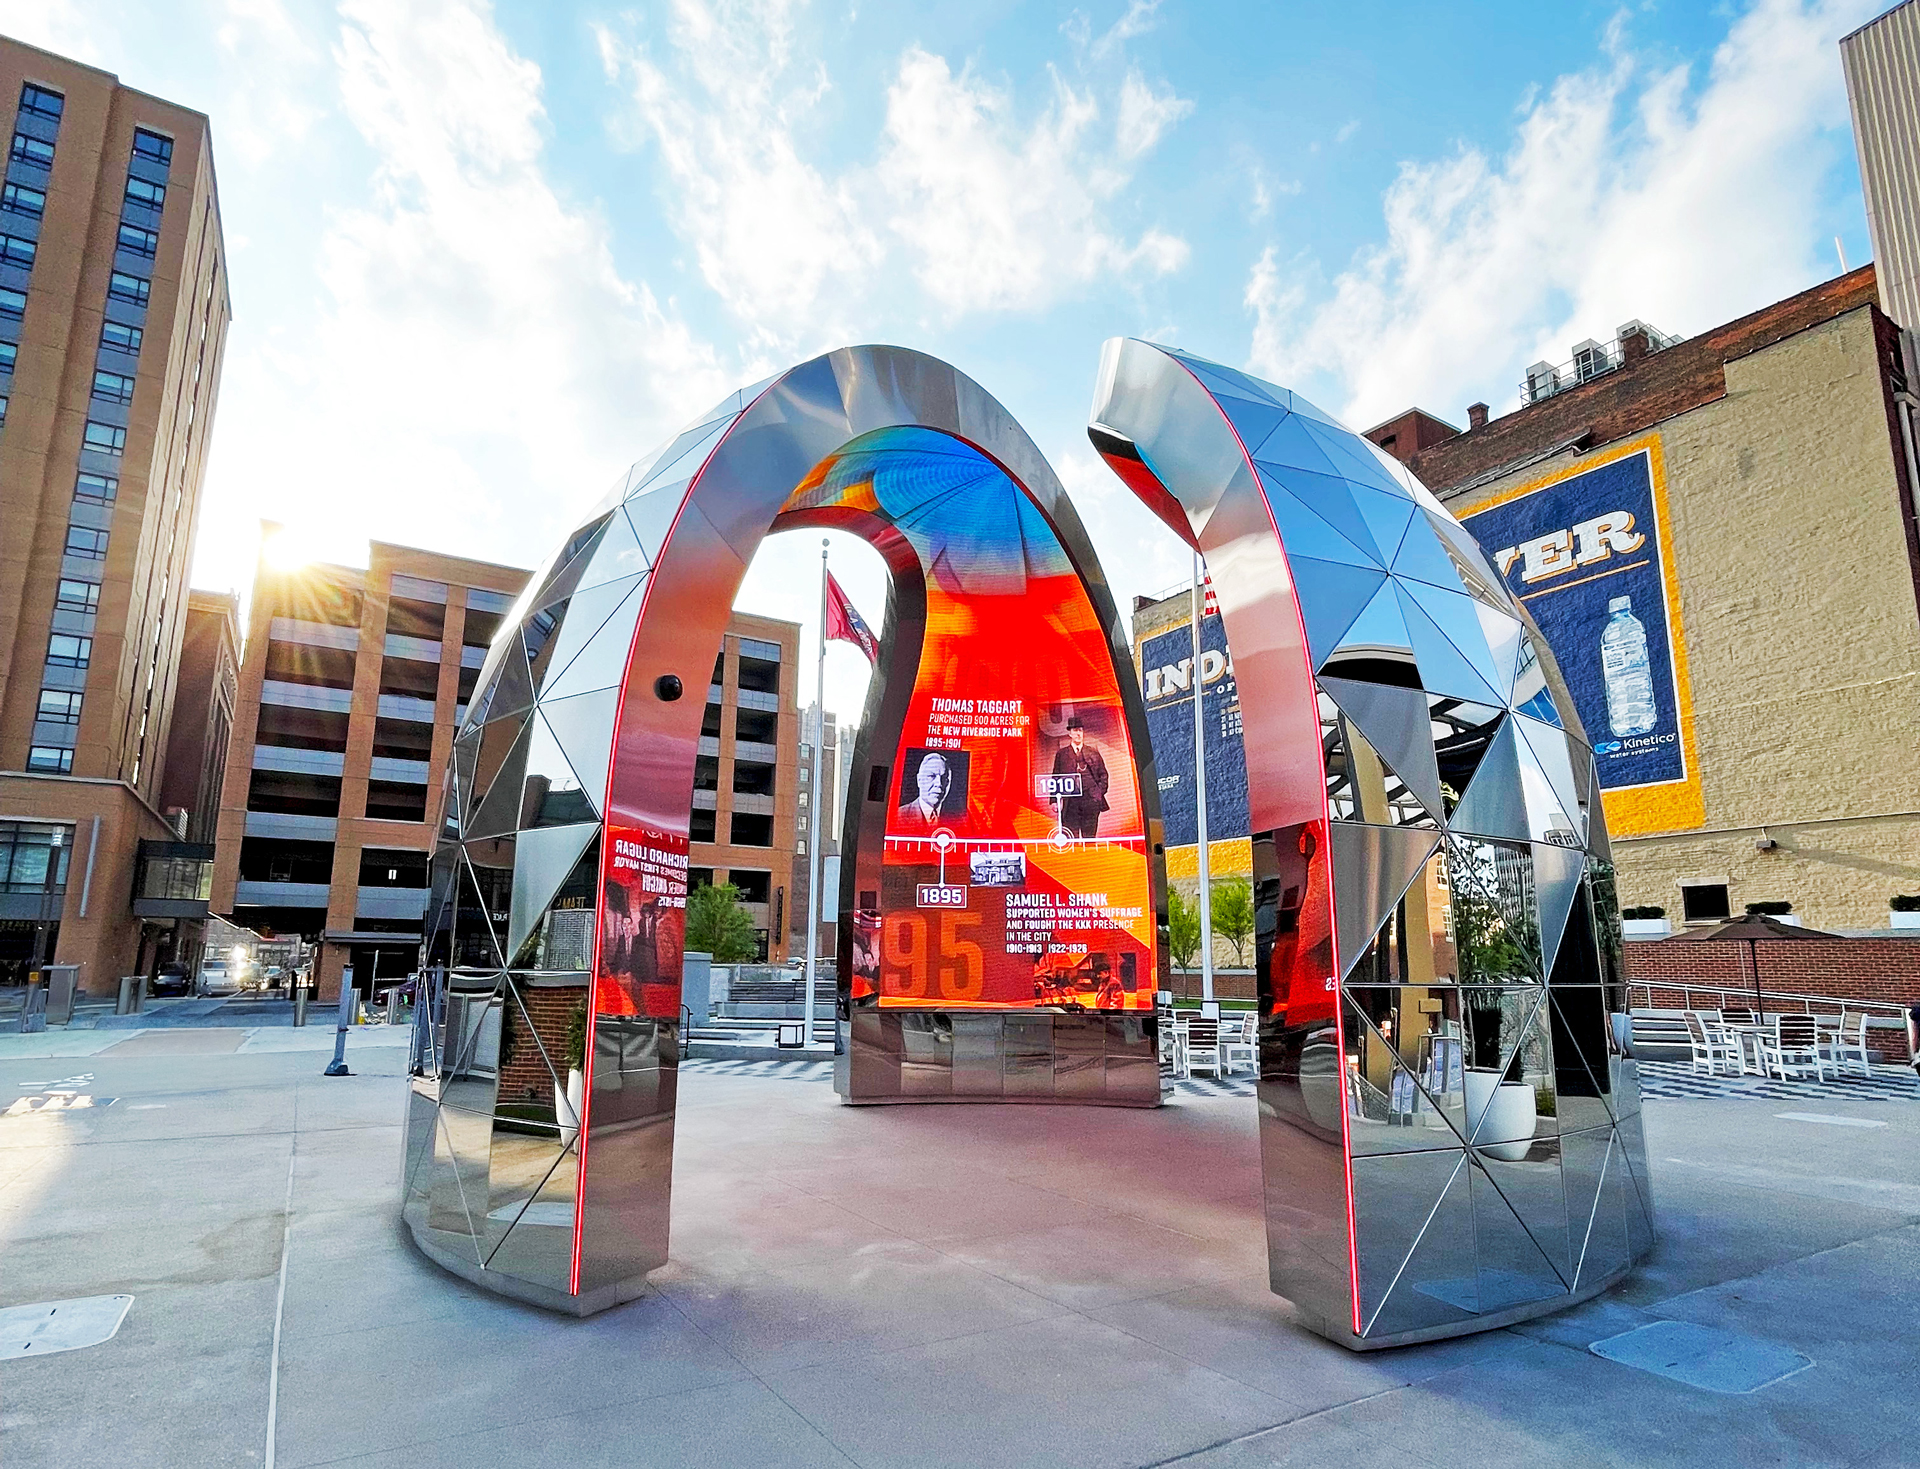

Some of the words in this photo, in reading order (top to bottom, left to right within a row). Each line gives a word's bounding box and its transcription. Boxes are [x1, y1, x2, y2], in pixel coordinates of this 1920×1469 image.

[931, 698, 974, 713] THOMAS
[976, 700, 1022, 714] TAGGART
[929, 713, 973, 725] PURCHASED
[989, 715, 1014, 726] ACRES
[1015, 715, 1030, 726] FOR
[927, 725, 941, 735] THE
[942, 726, 962, 736] NEW
[961, 726, 1001, 737] RIVERSIDE
[1002, 727, 1023, 737] PARK
[925, 737, 961, 748] 1895-1901
[1623, 733, 1675, 750] Kinetico
[1040, 778, 1075, 793] 1910
[921, 888, 963, 904] 1895
[1005, 893, 1053, 907] SAMUEL
[1055, 894, 1066, 906] L.
[1068, 893, 1108, 906] SHANK
[1005, 907, 1056, 918] SUPPORTED
[1057, 908, 1098, 918] WOMEN'S
[1099, 907, 1142, 917] SUFFRAGE
[1006, 919, 1023, 930] AND
[1024, 920, 1056, 930] FOUGHT
[1057, 920, 1074, 930] THE
[1075, 920, 1092, 930] KKK
[1093, 919, 1135, 930] PRESENCE
[1006, 931, 1015, 942] IN
[1016, 932, 1032, 942] THE
[1033, 931, 1052, 942] CITY
[1006, 943, 1043, 954] 1910-1913
[1048, 943, 1088, 954] 1922-1926
